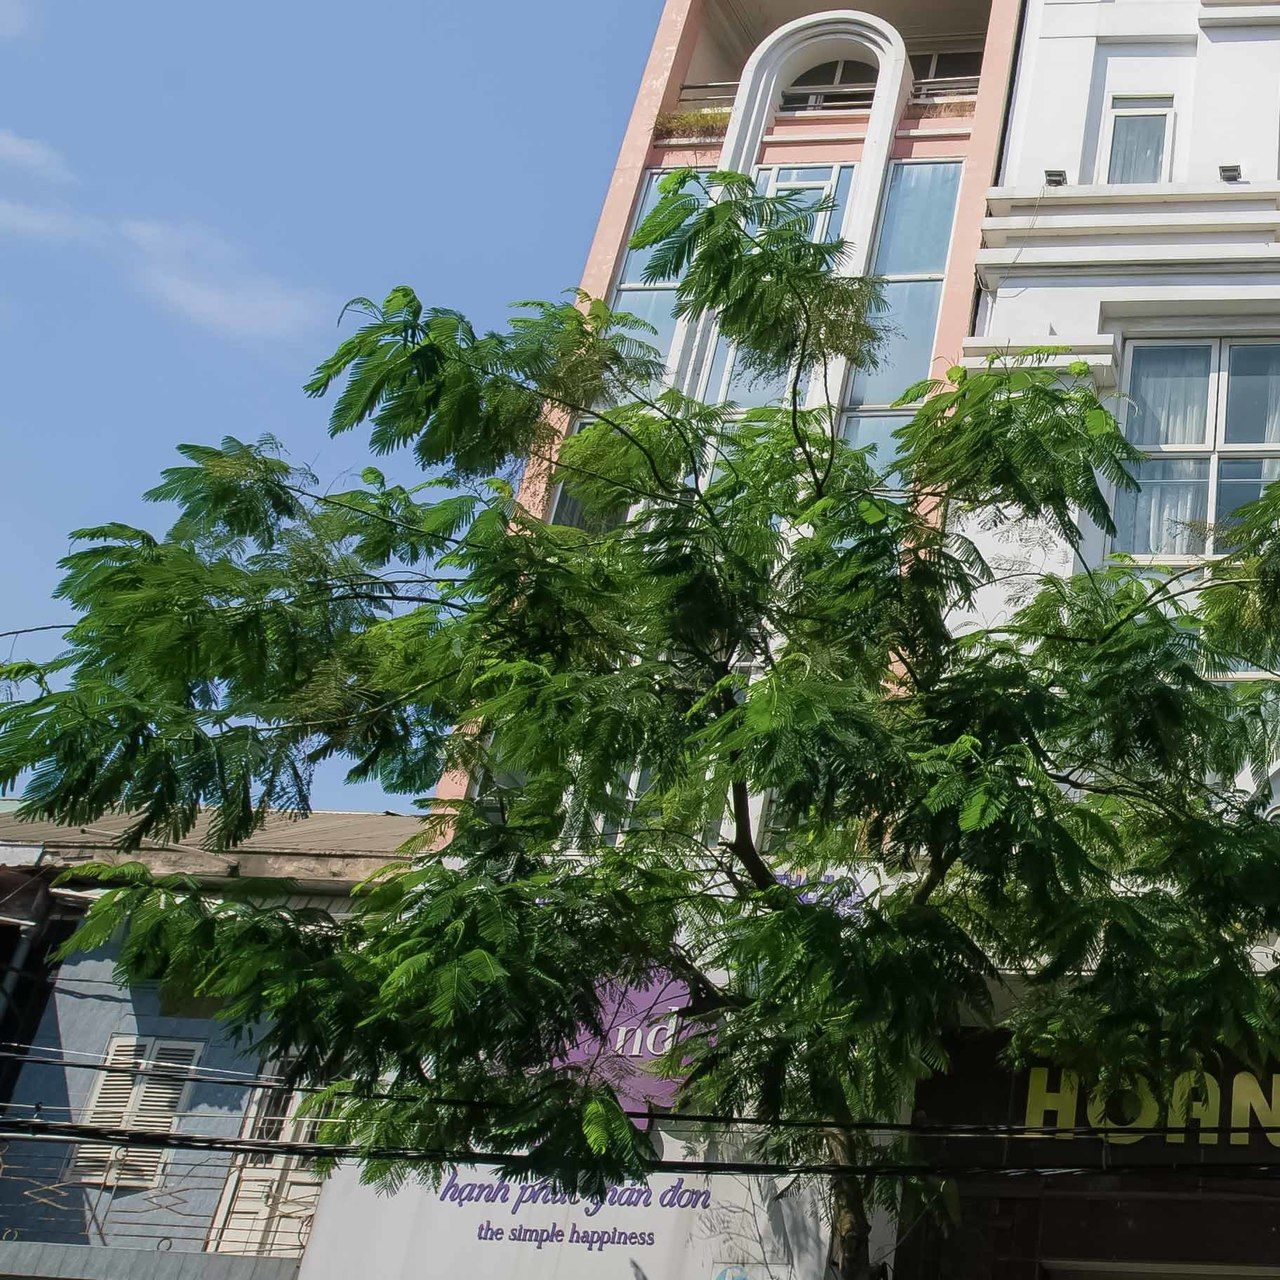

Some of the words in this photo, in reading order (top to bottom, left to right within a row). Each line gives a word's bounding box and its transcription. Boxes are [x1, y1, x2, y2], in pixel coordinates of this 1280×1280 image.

[477, 1220, 504, 1242] the
[508, 1222, 565, 1250] simple
[568, 1223, 656, 1252] happiness
